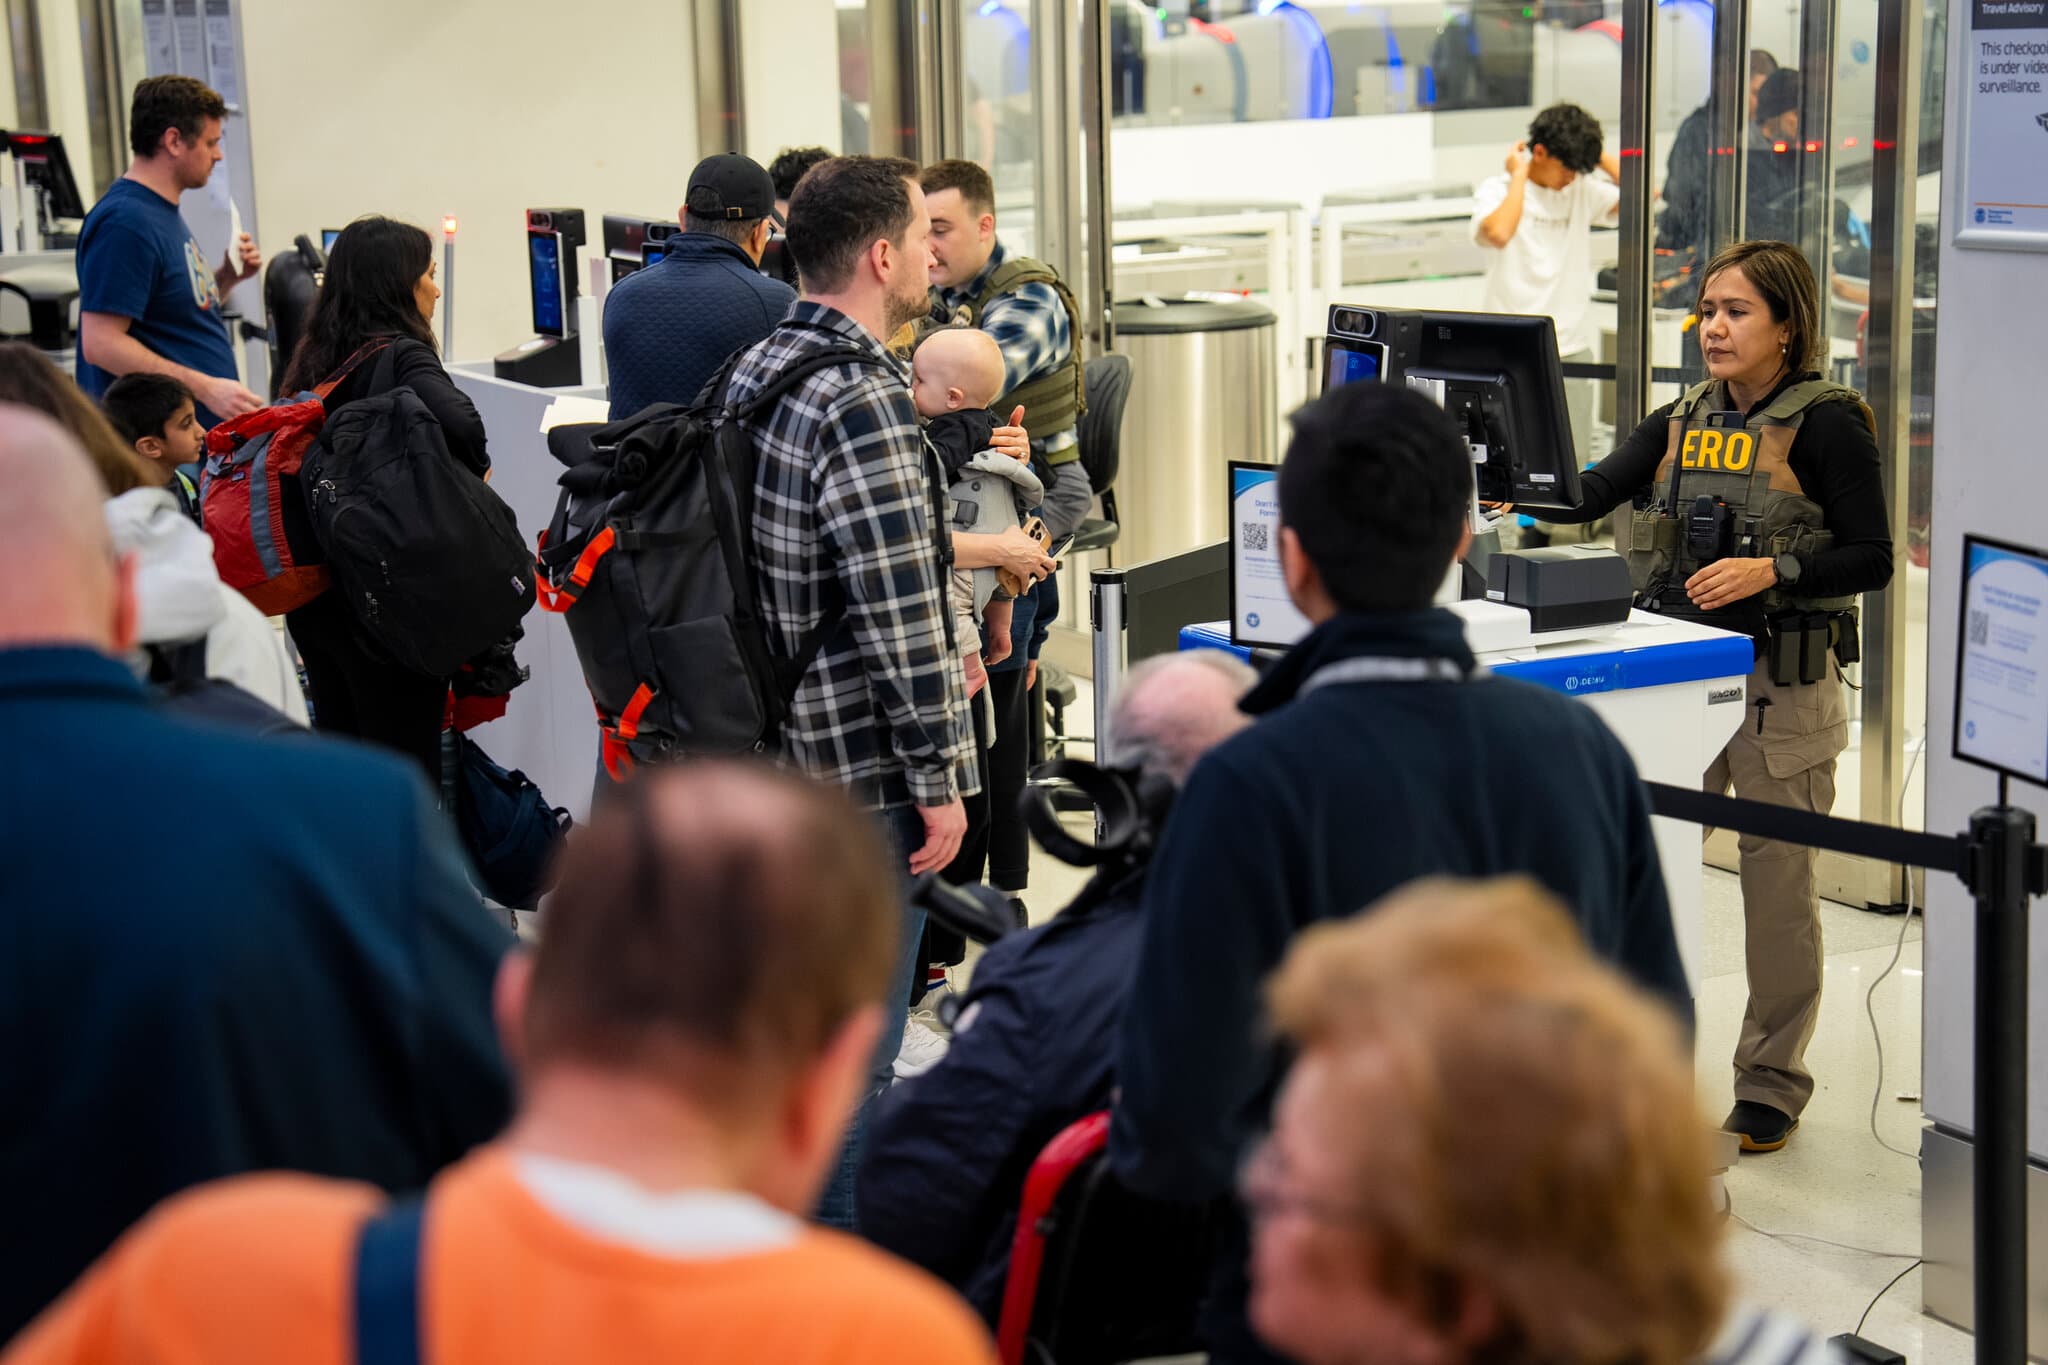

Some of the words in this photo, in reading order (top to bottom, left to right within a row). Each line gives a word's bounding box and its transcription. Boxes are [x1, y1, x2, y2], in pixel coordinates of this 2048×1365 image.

[1982, 3, 2007, 14] Travel
[2007, 2, 2045, 15] Advisory
[1981, 41, 2002, 56] This
[1980, 61, 1988, 74] is
[1990, 60, 2021, 74] under
[2023, 60, 2048, 74] vide
[1979, 79, 2042, 94] surveillance.
[1681, 429, 1753, 471] ERO
